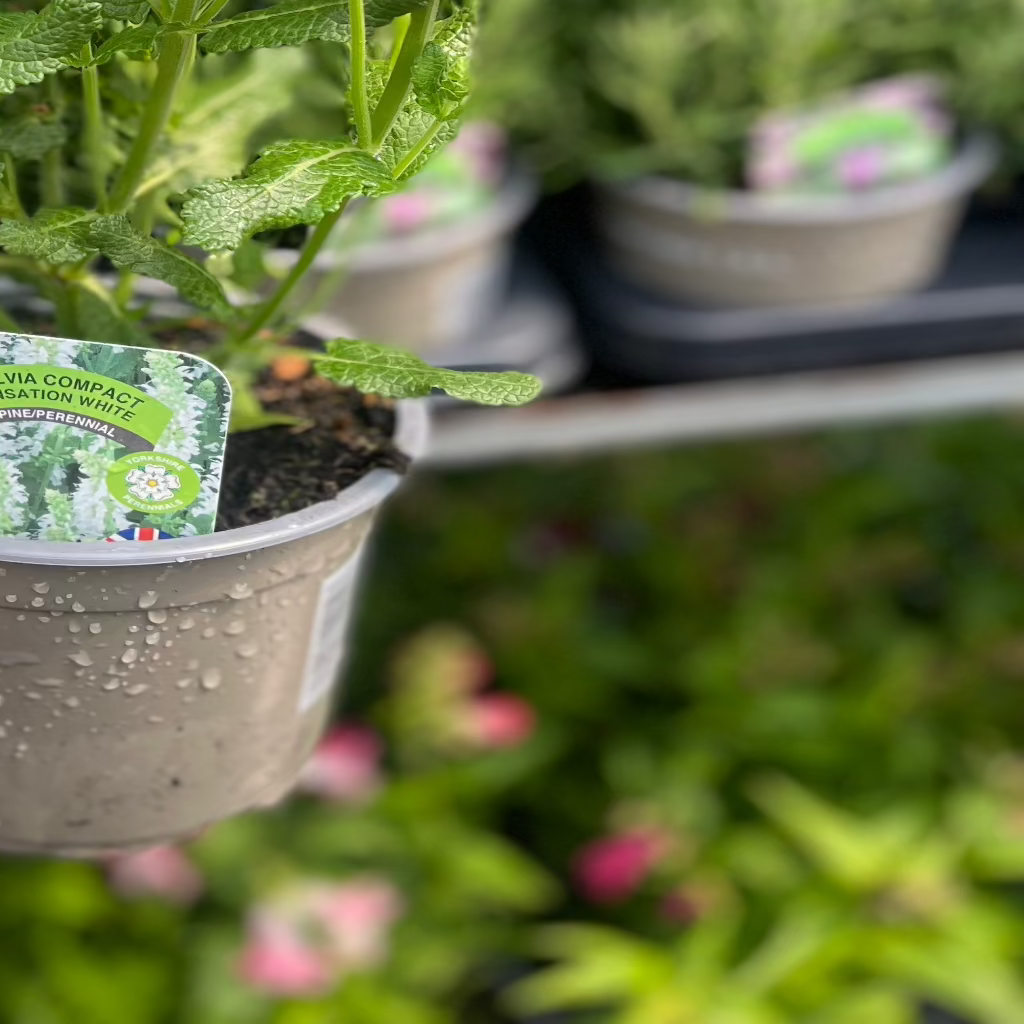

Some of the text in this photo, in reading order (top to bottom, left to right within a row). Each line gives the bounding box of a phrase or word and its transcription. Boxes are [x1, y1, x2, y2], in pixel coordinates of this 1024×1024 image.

[43, 373, 145, 409] COMPACT
[79, 395, 136, 422] WHITE
[125, 455, 185, 471] YORKSHIRE
